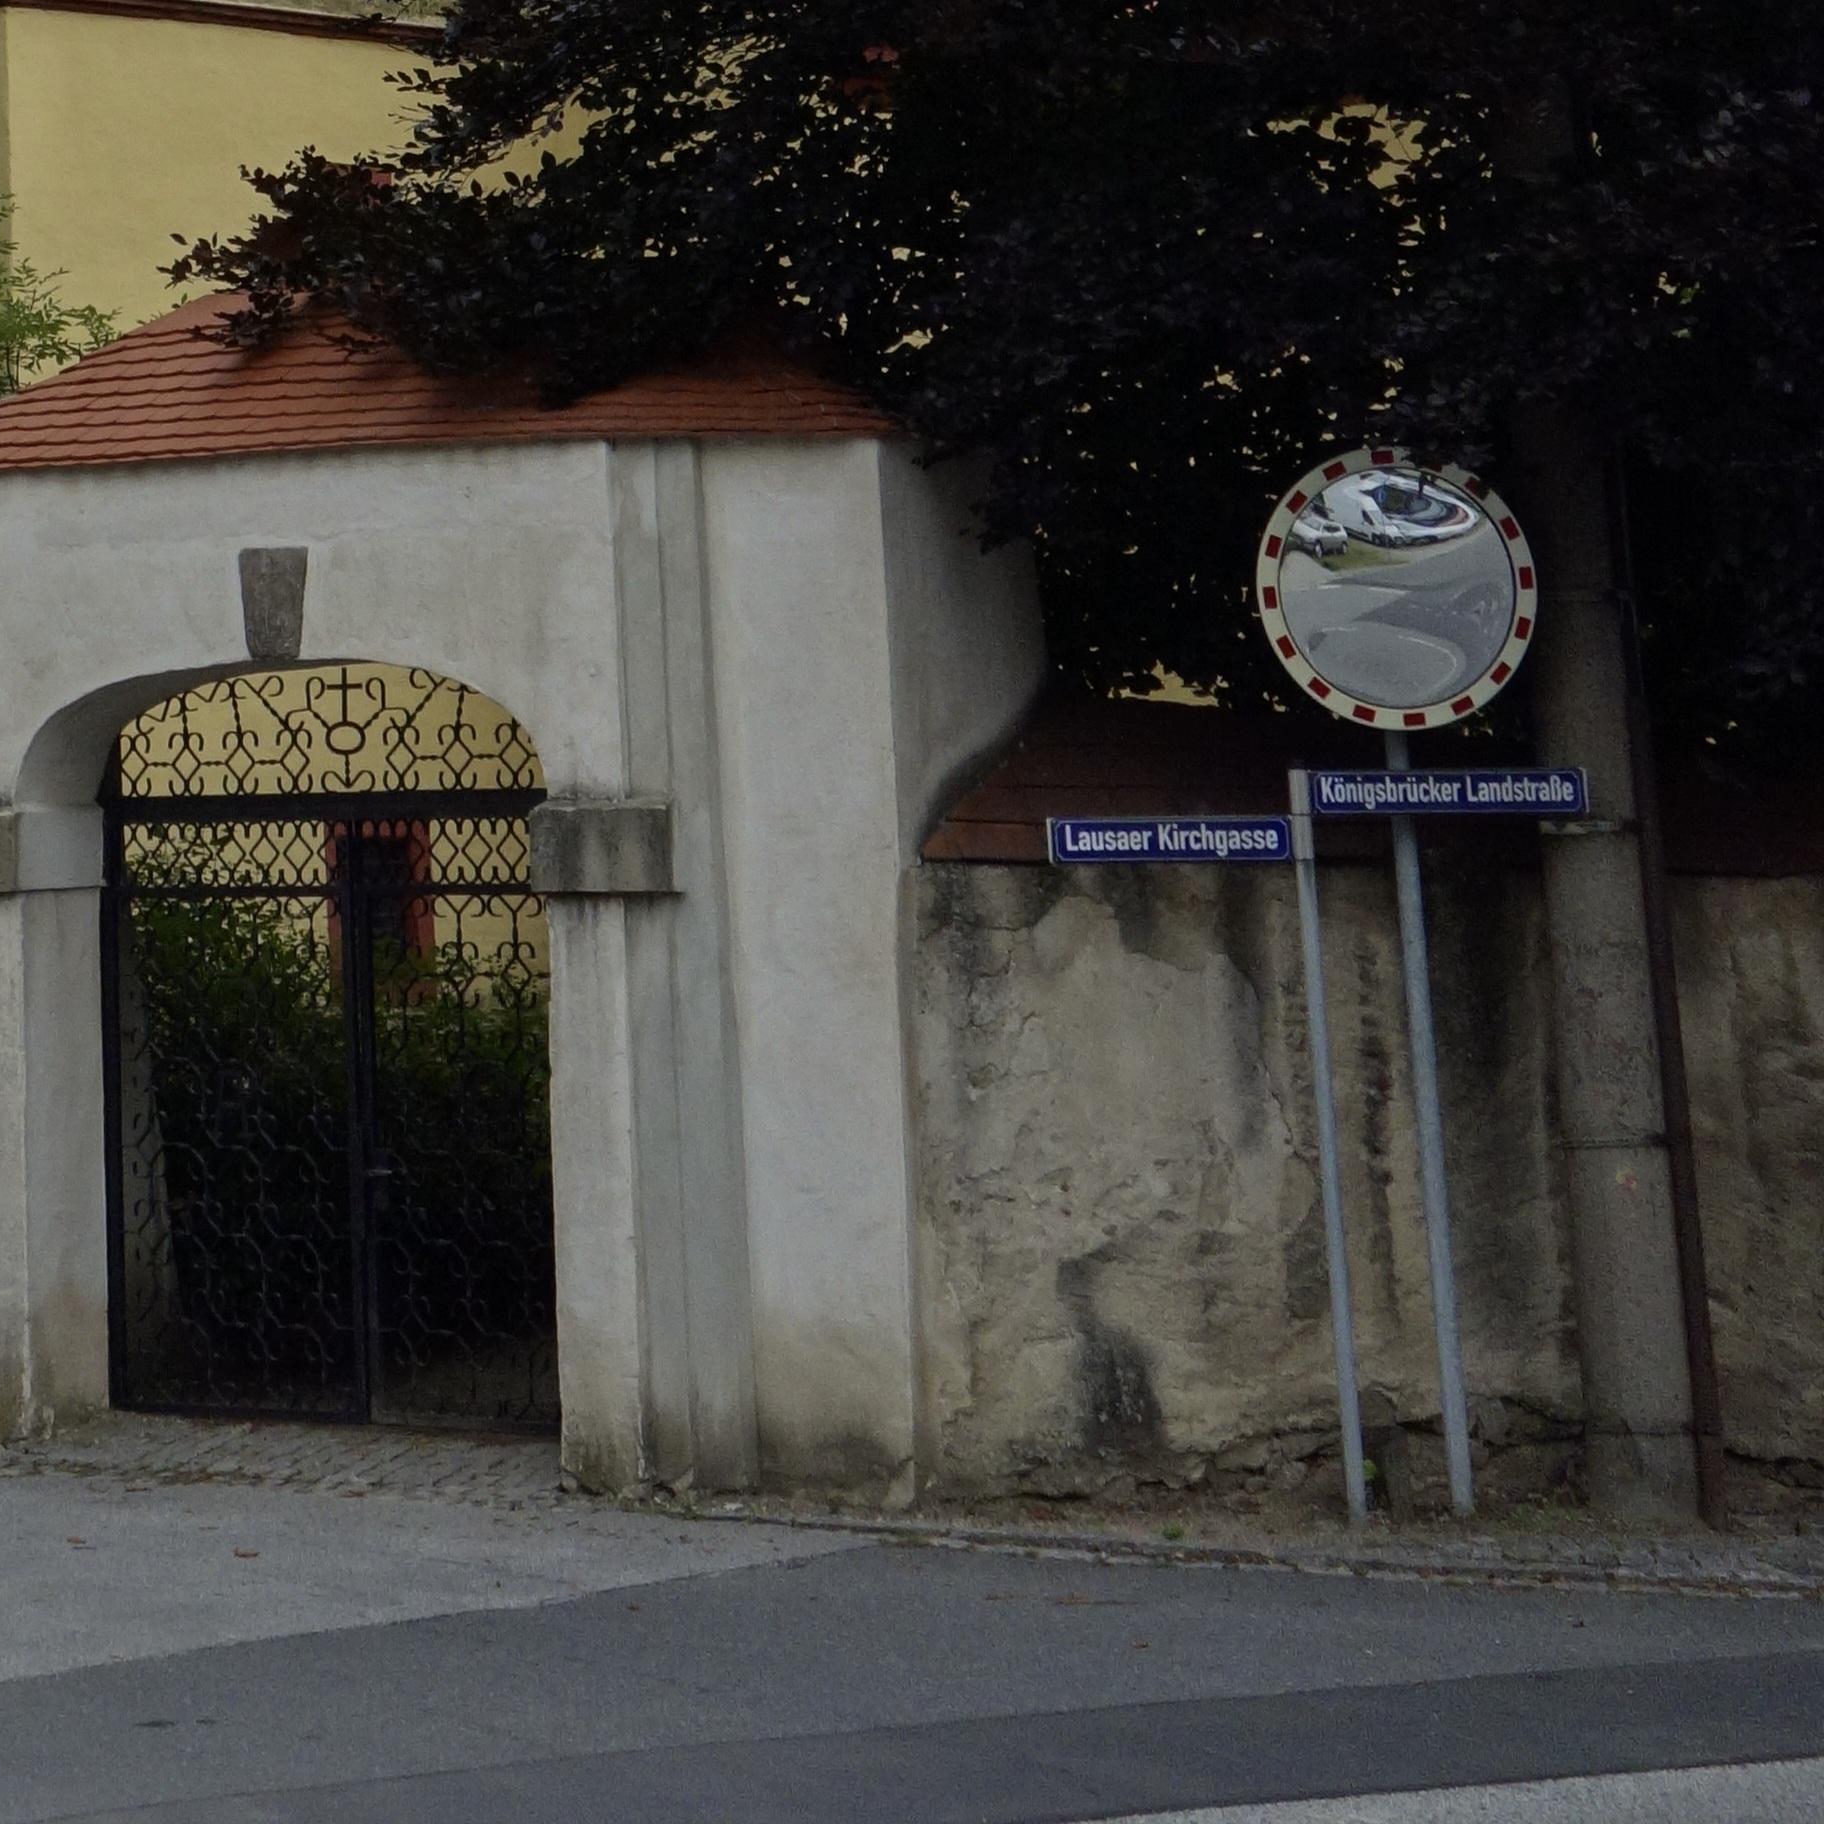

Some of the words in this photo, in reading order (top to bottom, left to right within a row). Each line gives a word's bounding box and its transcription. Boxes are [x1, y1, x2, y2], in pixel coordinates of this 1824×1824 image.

[1320, 775, 1461, 810] Königsbrücker
[1466, 774, 1574, 802] Landstraße
[1065, 824, 1152, 851] Lausaer
[1157, 823, 1279, 857] Kirchgasse
